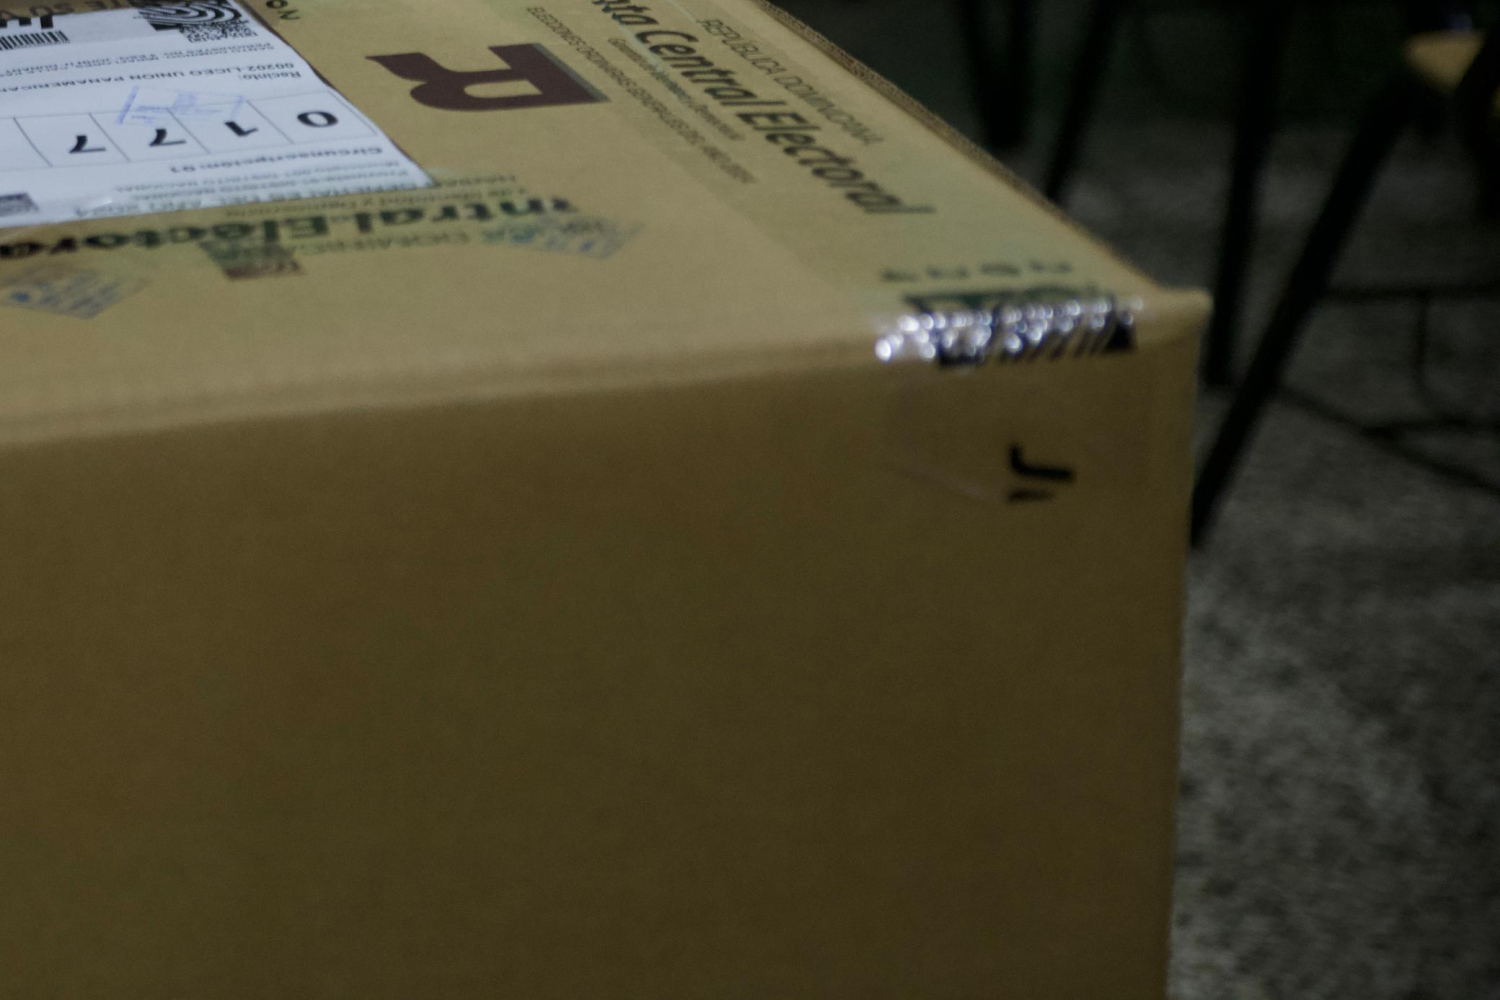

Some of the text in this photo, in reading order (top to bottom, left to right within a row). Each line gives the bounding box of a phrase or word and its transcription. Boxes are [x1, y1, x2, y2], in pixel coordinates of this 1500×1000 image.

[129, 70, 185, 80] UNION
[239, 71, 301, 81] Recinto:
[366, 42, 610, 111] R
[634, 29, 756, 108] Central
[737, 111, 937, 216] Electoral
